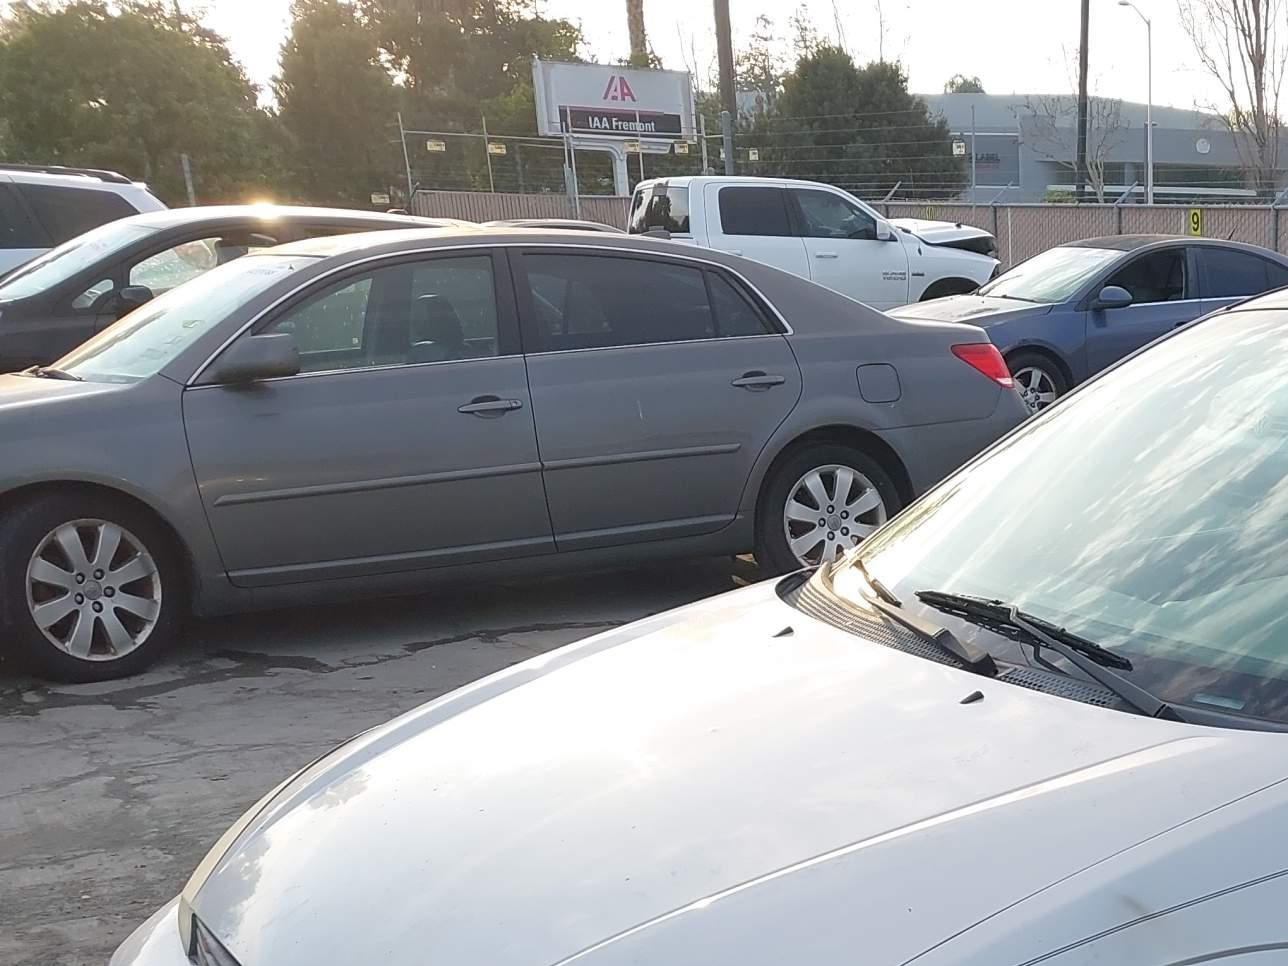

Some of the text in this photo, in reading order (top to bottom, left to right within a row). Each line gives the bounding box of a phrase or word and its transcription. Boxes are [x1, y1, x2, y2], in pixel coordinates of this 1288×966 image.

[588, 116, 655, 131] IAA Fremont
[1191, 212, 1200, 232] 9
